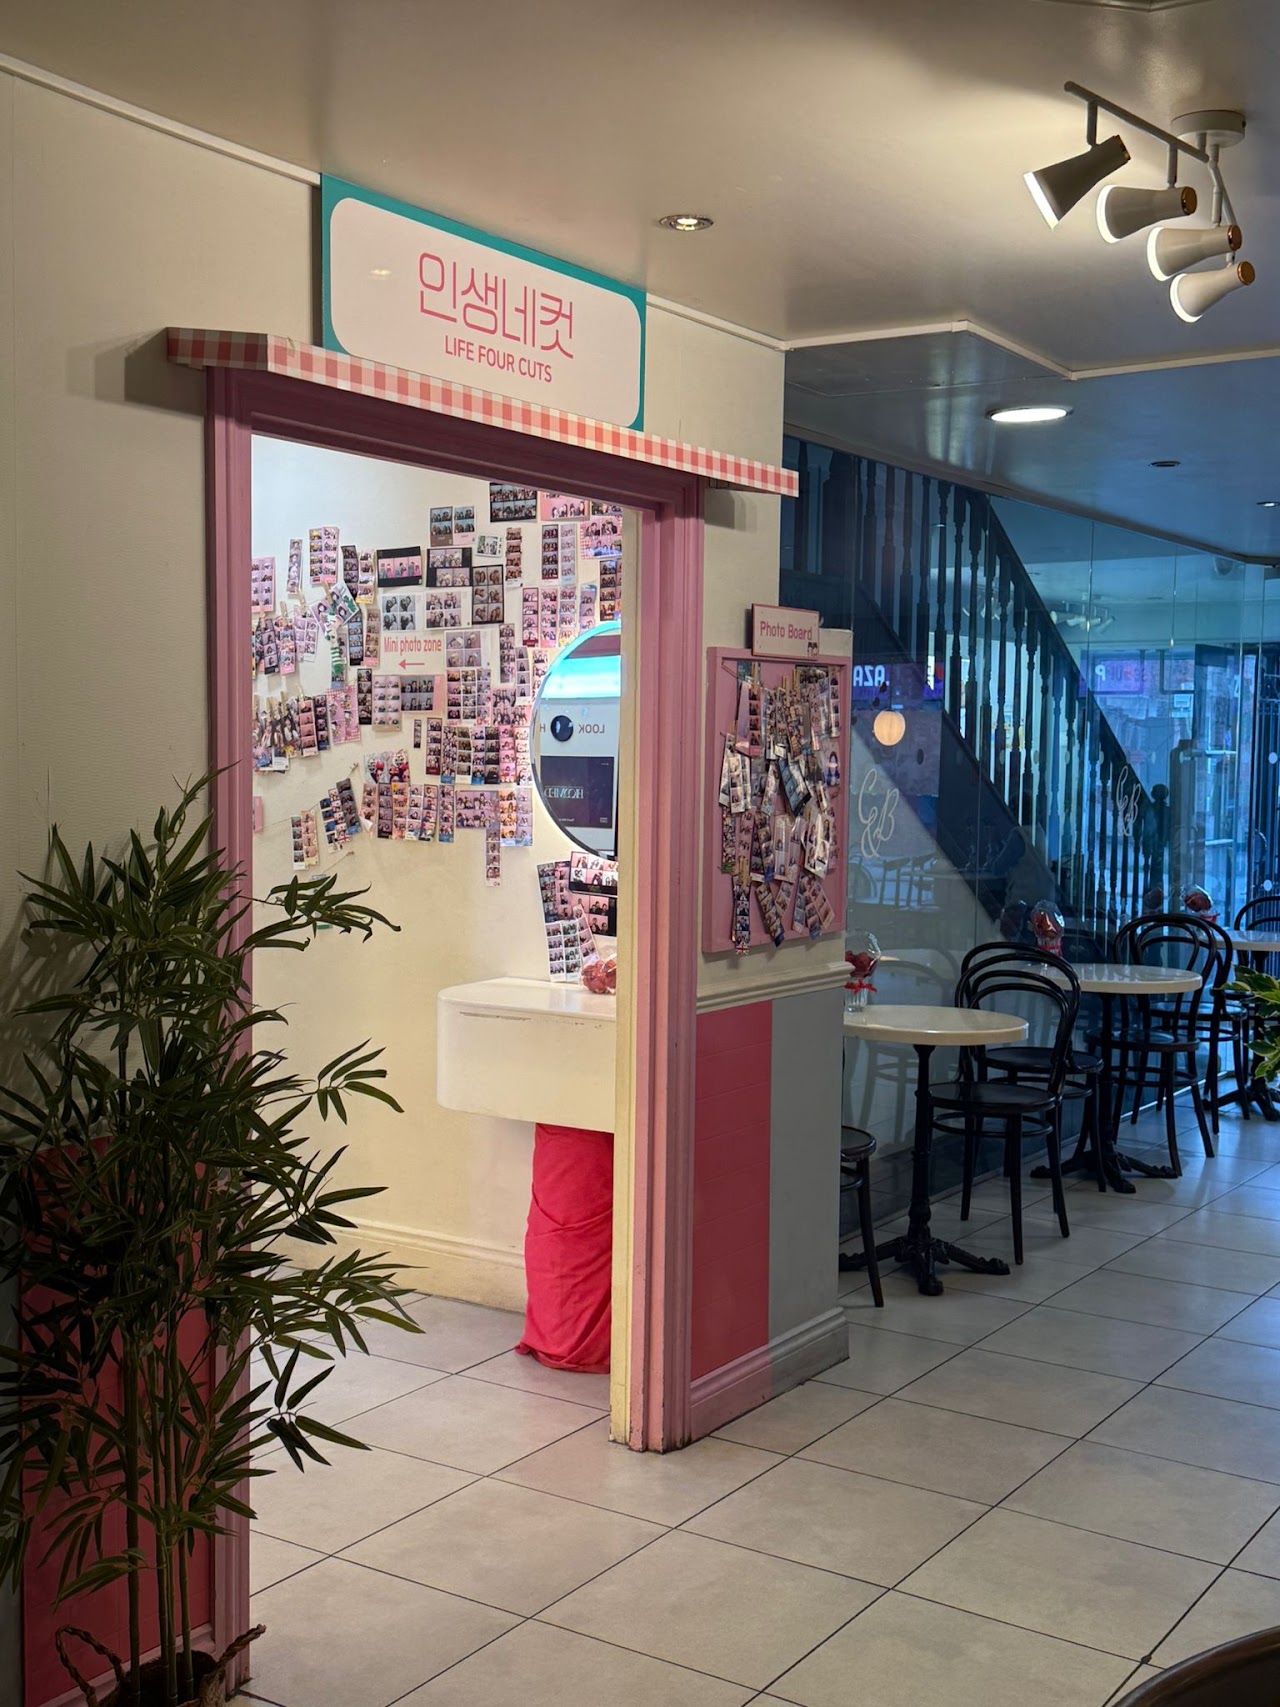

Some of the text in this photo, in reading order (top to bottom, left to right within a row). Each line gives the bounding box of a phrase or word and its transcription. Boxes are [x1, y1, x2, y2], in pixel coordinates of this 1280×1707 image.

[418, 252, 575, 360] 인생네컷
[445, 335, 553, 383] LIFE FOUR CUTS
[384, 636, 442, 656] Mini photo zone
[760, 621, 813, 641] Photo Board
